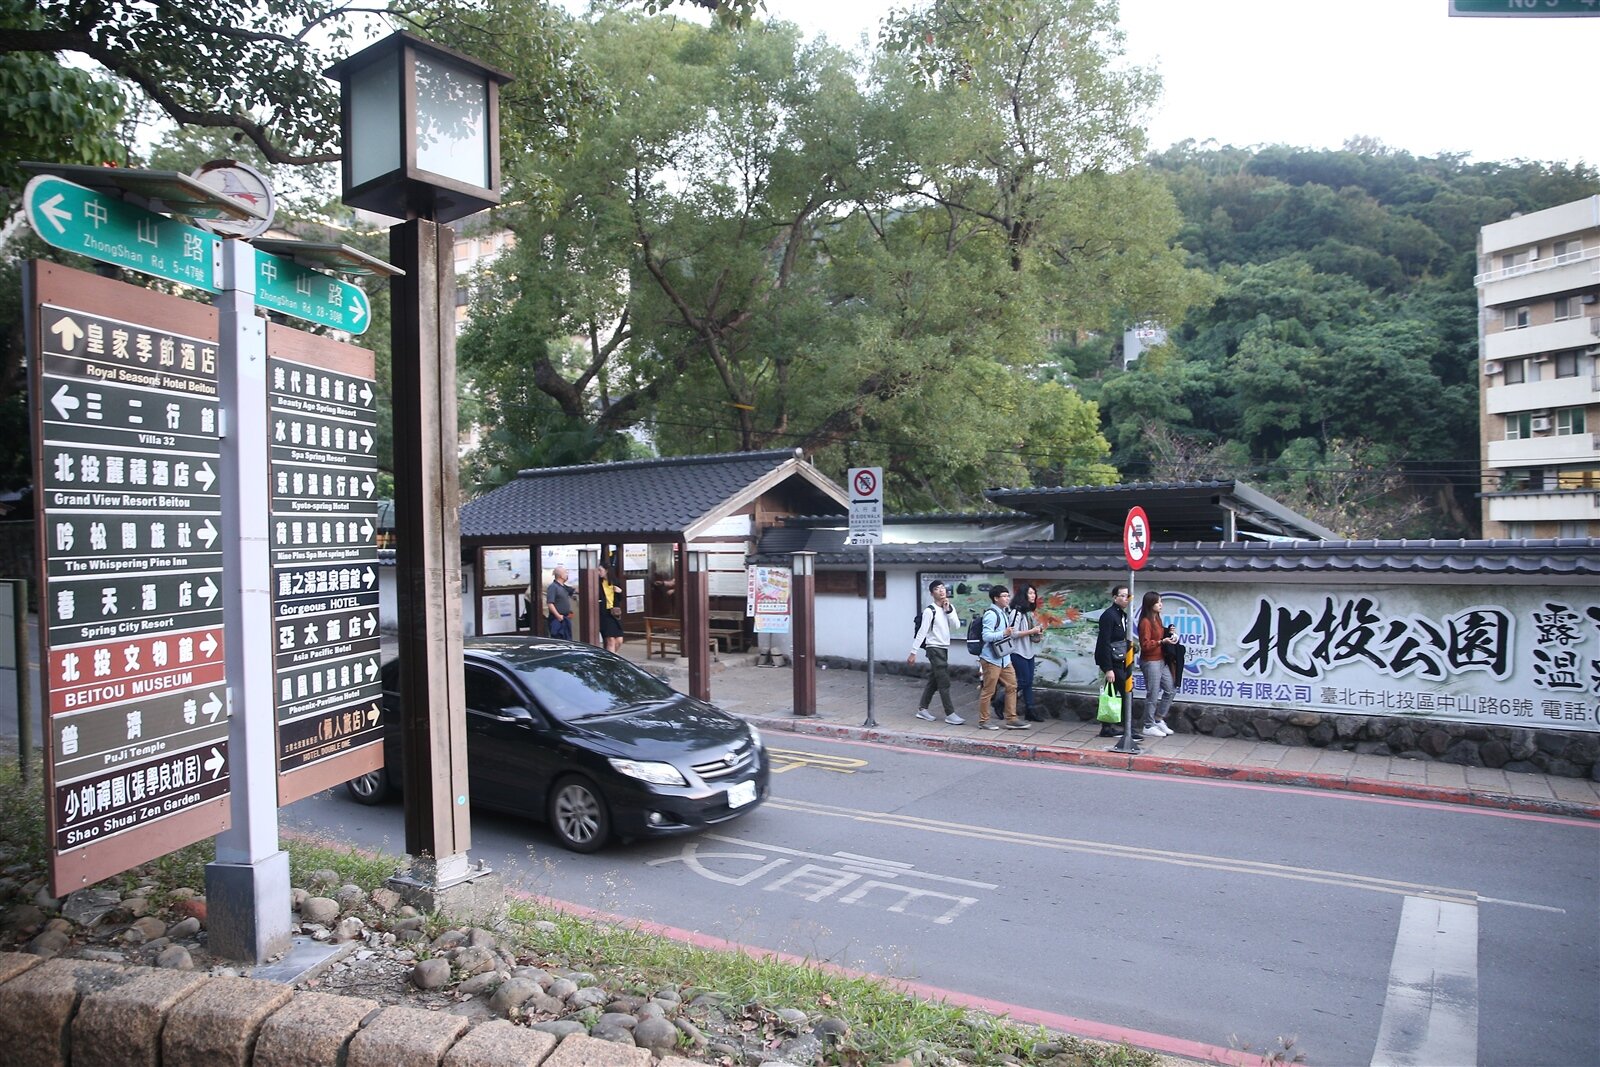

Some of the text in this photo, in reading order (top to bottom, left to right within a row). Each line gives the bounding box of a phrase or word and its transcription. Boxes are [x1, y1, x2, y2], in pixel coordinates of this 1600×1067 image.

[84, 199, 203, 262] 中山路
[84, 233, 143, 262] ZhongShan
[261, 260, 343, 307] 中山路
[87, 323, 215, 374] 皇家季節酒店
[87, 364, 216, 394] Royal Seasons Hotel Beitou
[86, 392, 215, 433] 三二行館
[277, 396, 357, 417] Beauty Age Spring Resort
[138, 434, 176, 446] Villa 32
[54, 453, 190, 487] 北投麗禧酒店
[291, 450, 347, 463] Spa Spring Resort
[54, 493, 191, 508] Grand View Resort Beitou
[291, 501, 350, 512] Kyoto-spring Hotel
[56, 521, 192, 551] 吟松閣旅社
[65, 557, 188, 571] The Whispering Pine Inn
[278, 552, 292, 560] Nine
[293, 551, 306, 559] Plus
[306, 551, 317, 560] Spa
[328, 550, 345, 559] spring
[345, 549, 360, 557] Hotel
[279, 567, 361, 597] 麗之湯溫泉會館
[57, 581, 192, 620] 春天酒店
[280, 596, 360, 615] Gorgeous HOTEL
[81, 618, 174, 638] Spring City Resort
[280, 616, 361, 650] 亞太飯店
[1241, 597, 1510, 678] 北投公園
[61, 636, 194, 682] 北投文物館
[293, 644, 352, 662] Asia Pacific Hotel
[65, 671, 193, 708] BEITOU MUSEUM
[343, 689, 360, 700] Hotel
[1319, 686, 1535, 718] 臺北市北投區中山路6號
[61, 699, 197, 756] 普濟寺
[104, 742, 166, 764] PuJi Temple
[302, 748, 321, 762] HOTEL
[64, 754, 201, 823] 少帥禪園(張學良故居)
[67, 792, 201, 845] Shao Shuai Zen Garden
